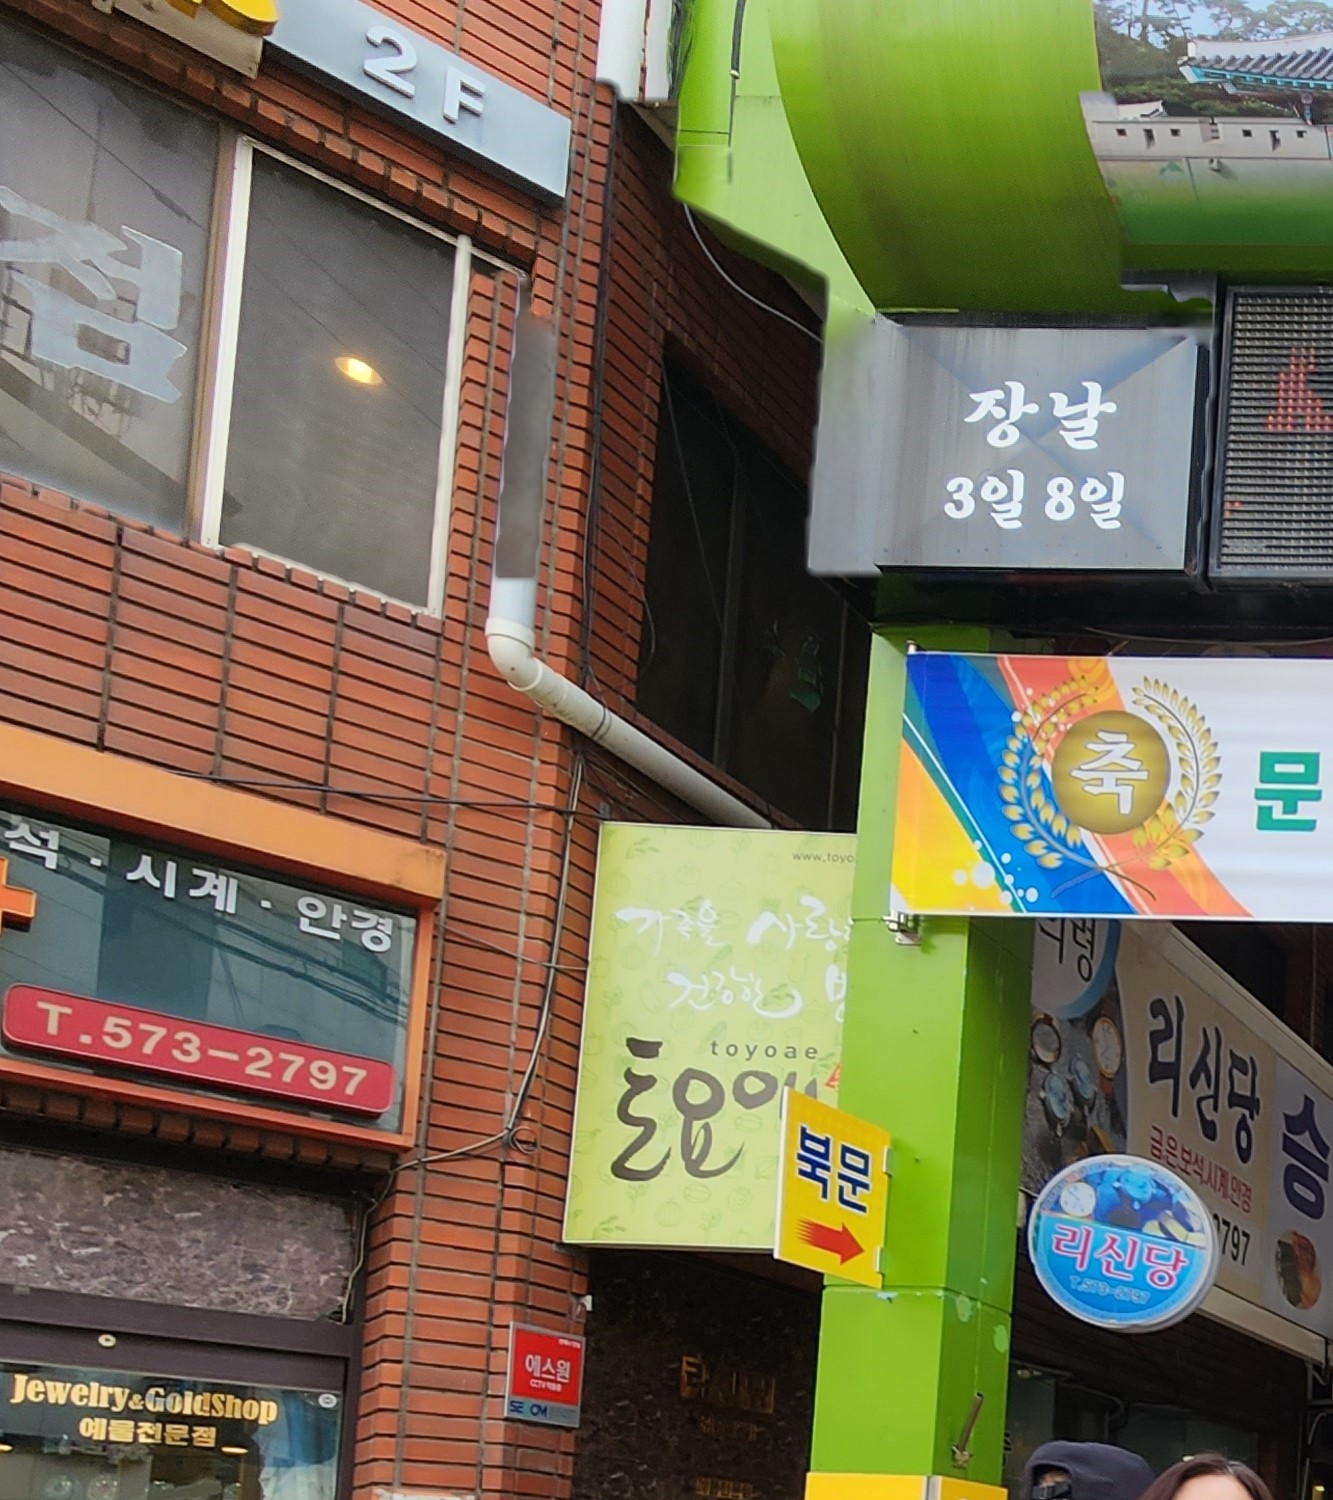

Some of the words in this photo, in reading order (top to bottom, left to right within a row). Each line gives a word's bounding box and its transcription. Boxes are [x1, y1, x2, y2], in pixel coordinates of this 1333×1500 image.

[964, 380, 1118, 450] 장날
[944, 469, 1024, 529] 3일
[1045, 470, 1125, 529] 8일
[1069, 729, 1149, 815] 축
[792, 852, 855, 864] www.toyo
[126, 854, 238, 914] 시계
[297, 896, 393, 952] 안경
[36, 1001, 368, 1096] T.573-2797
[711, 1039, 819, 1062] toyoae
[1147, 995, 1261, 1166] 리신당
[796, 1125, 873, 1215] 북문
[1052, 1222, 1190, 1289] 리신당
[525, 1354, 571, 1383] 에스원
[79, 1417, 218, 1448] 예물전문점
